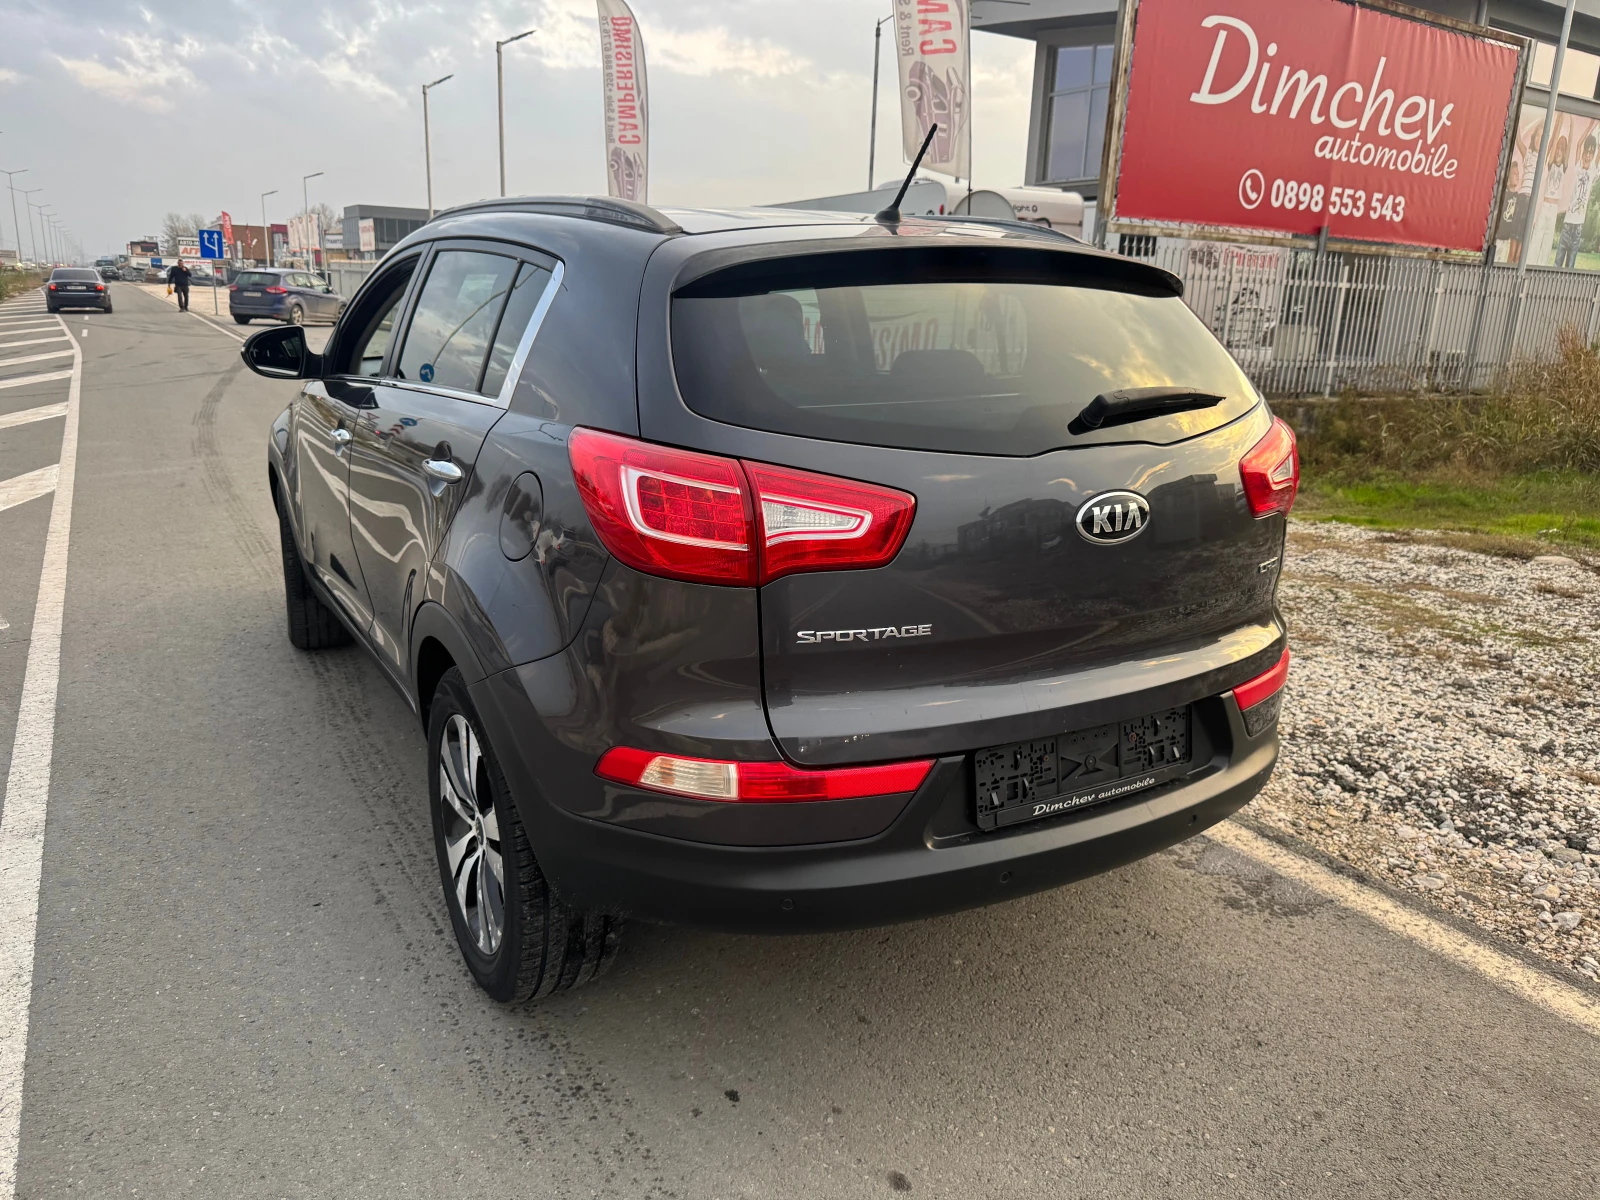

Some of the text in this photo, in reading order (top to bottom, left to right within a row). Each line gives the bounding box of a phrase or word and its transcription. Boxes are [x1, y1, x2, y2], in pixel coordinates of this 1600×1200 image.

[1190, 15, 1454, 144] Dimchev
[1315, 133, 1458, 180] automobile
[1271, 179, 1405, 222] 0898 553 543
[1092, 501, 1141, 533] KIA
[796, 624, 932, 643] SPORTAGE
[1033, 776, 1155, 816] Dimchev automobile
